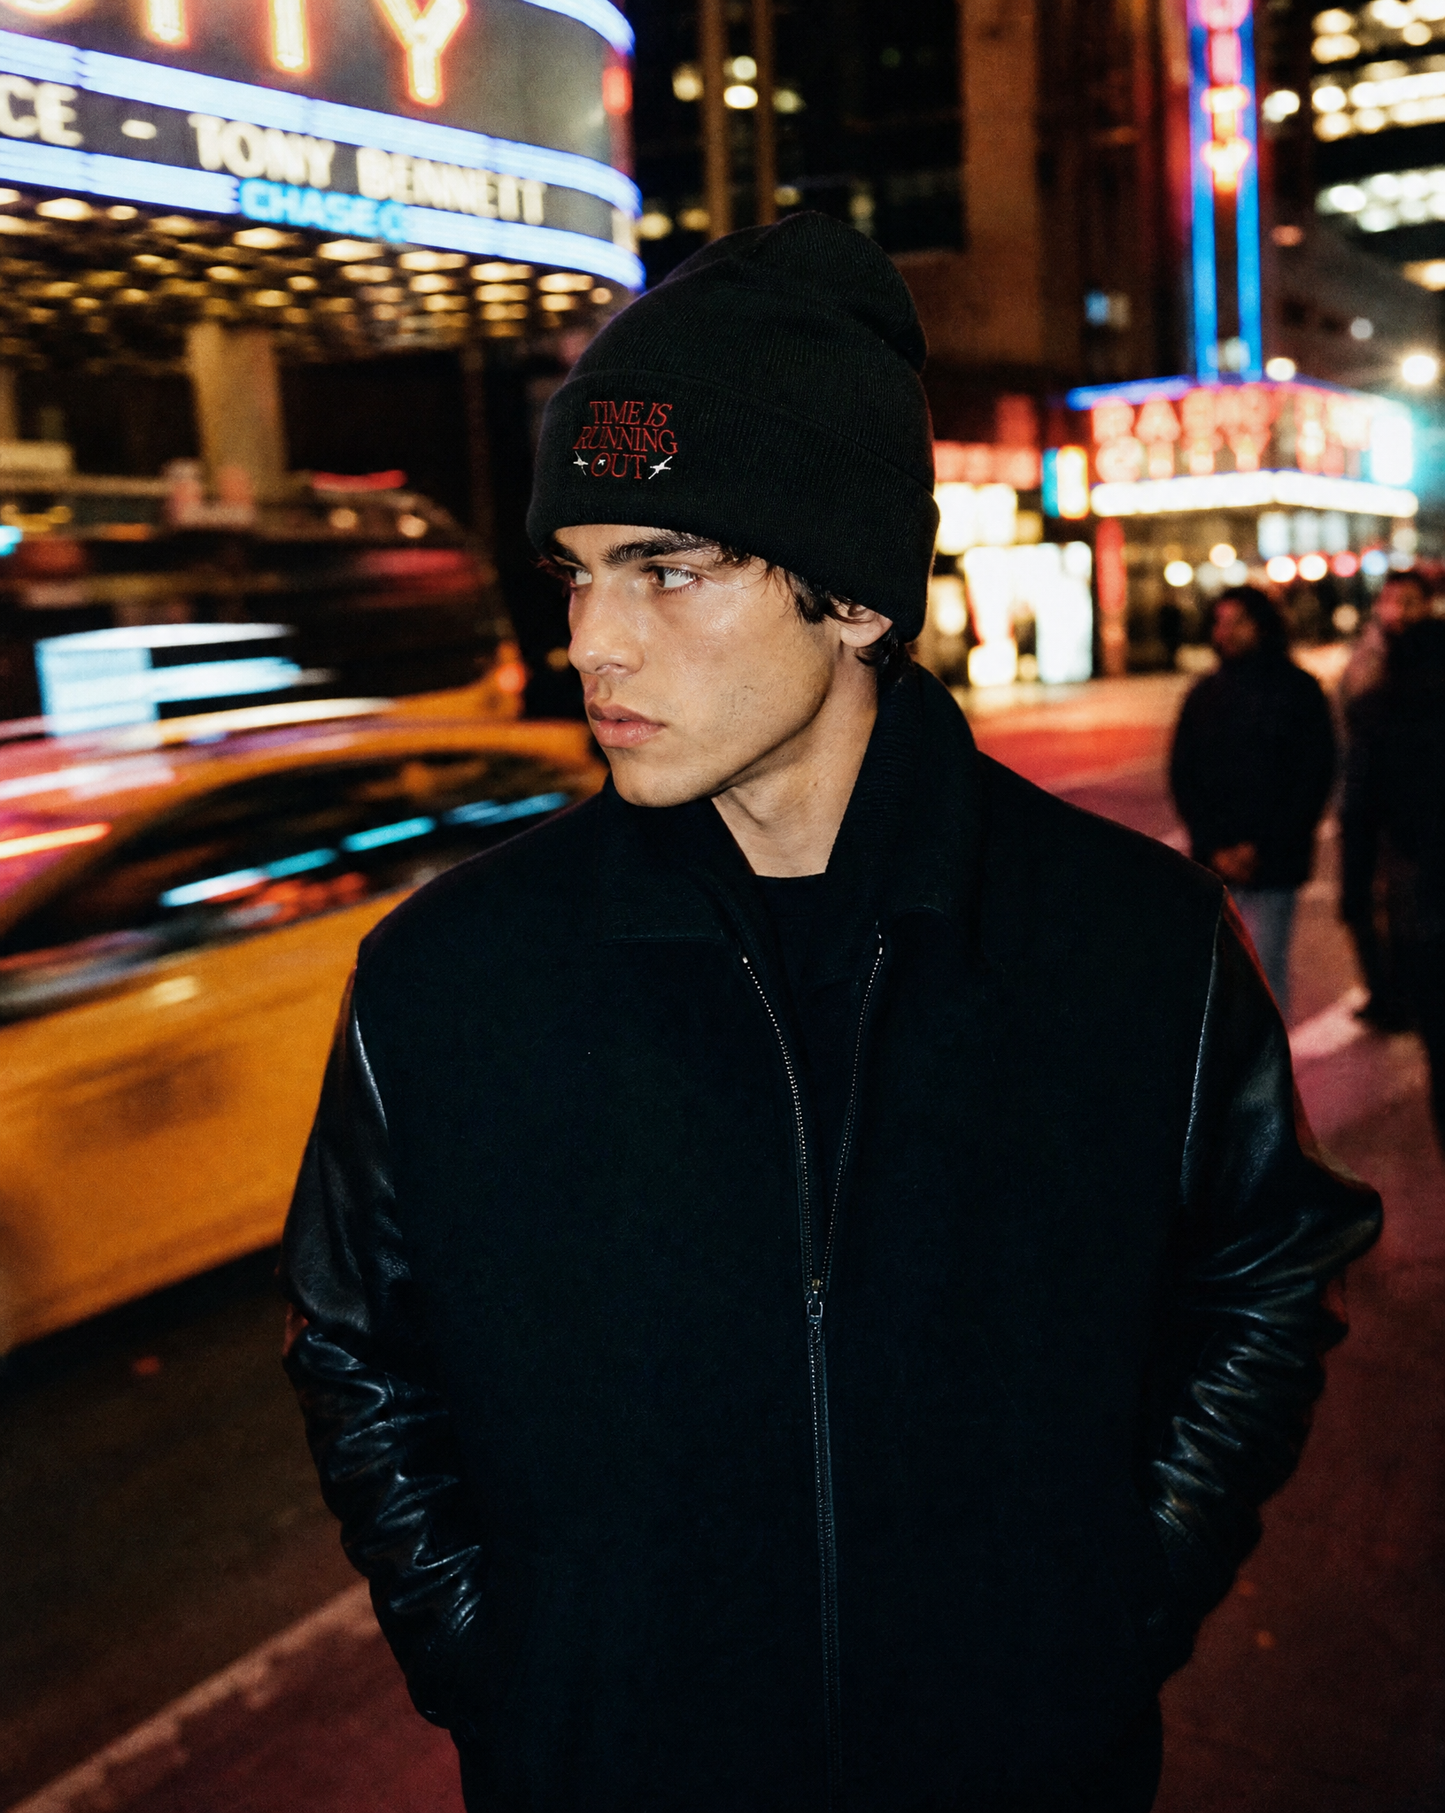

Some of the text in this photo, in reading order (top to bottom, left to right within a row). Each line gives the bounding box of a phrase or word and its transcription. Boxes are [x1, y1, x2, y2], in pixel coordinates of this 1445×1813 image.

[187, 112, 336, 189] TONY
[356, 147, 549, 226] BENNETT
[239, 177, 380, 238] CHASE
[589, 400, 673, 428] TIME IS
[572, 425, 679, 455] RUNNING
[590, 452, 647, 480] OUT
